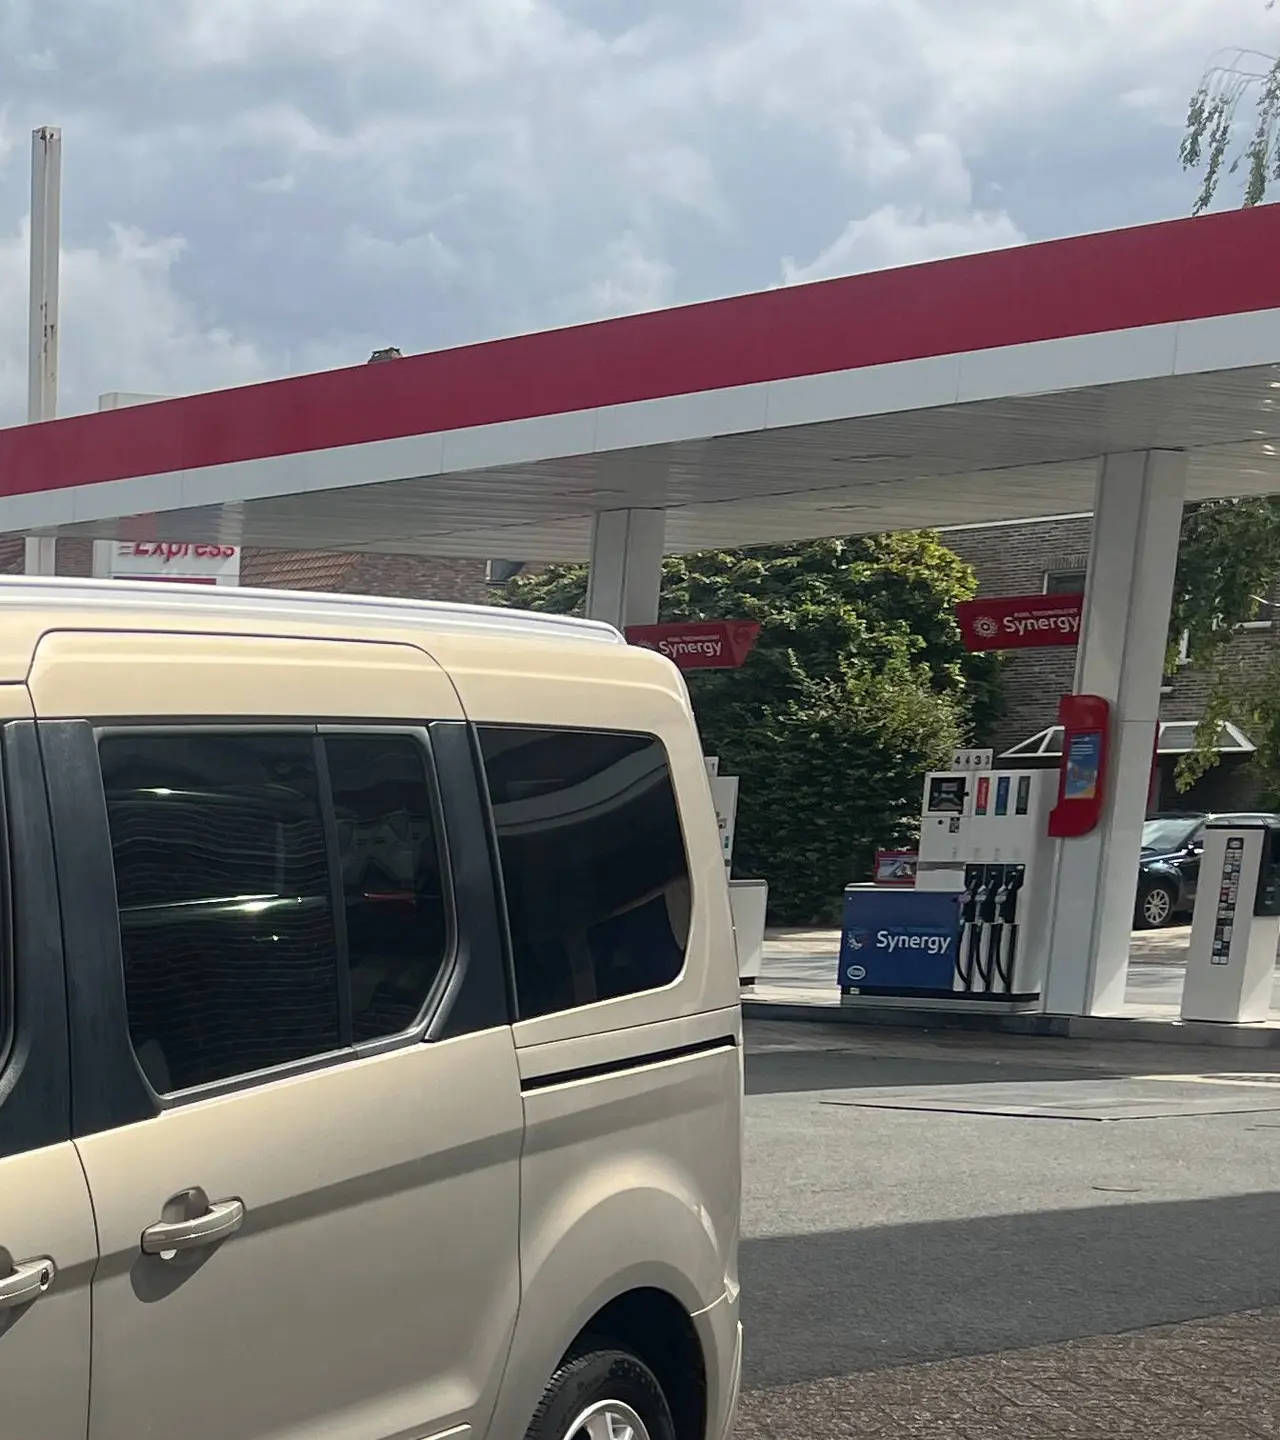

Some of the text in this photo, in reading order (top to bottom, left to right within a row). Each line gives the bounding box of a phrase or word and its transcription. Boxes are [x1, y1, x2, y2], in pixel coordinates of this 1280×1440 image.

[1002, 614, 1080, 636] Synergy
[658, 641, 722, 658] Synergy
[876, 930, 952, 954] Synergy
